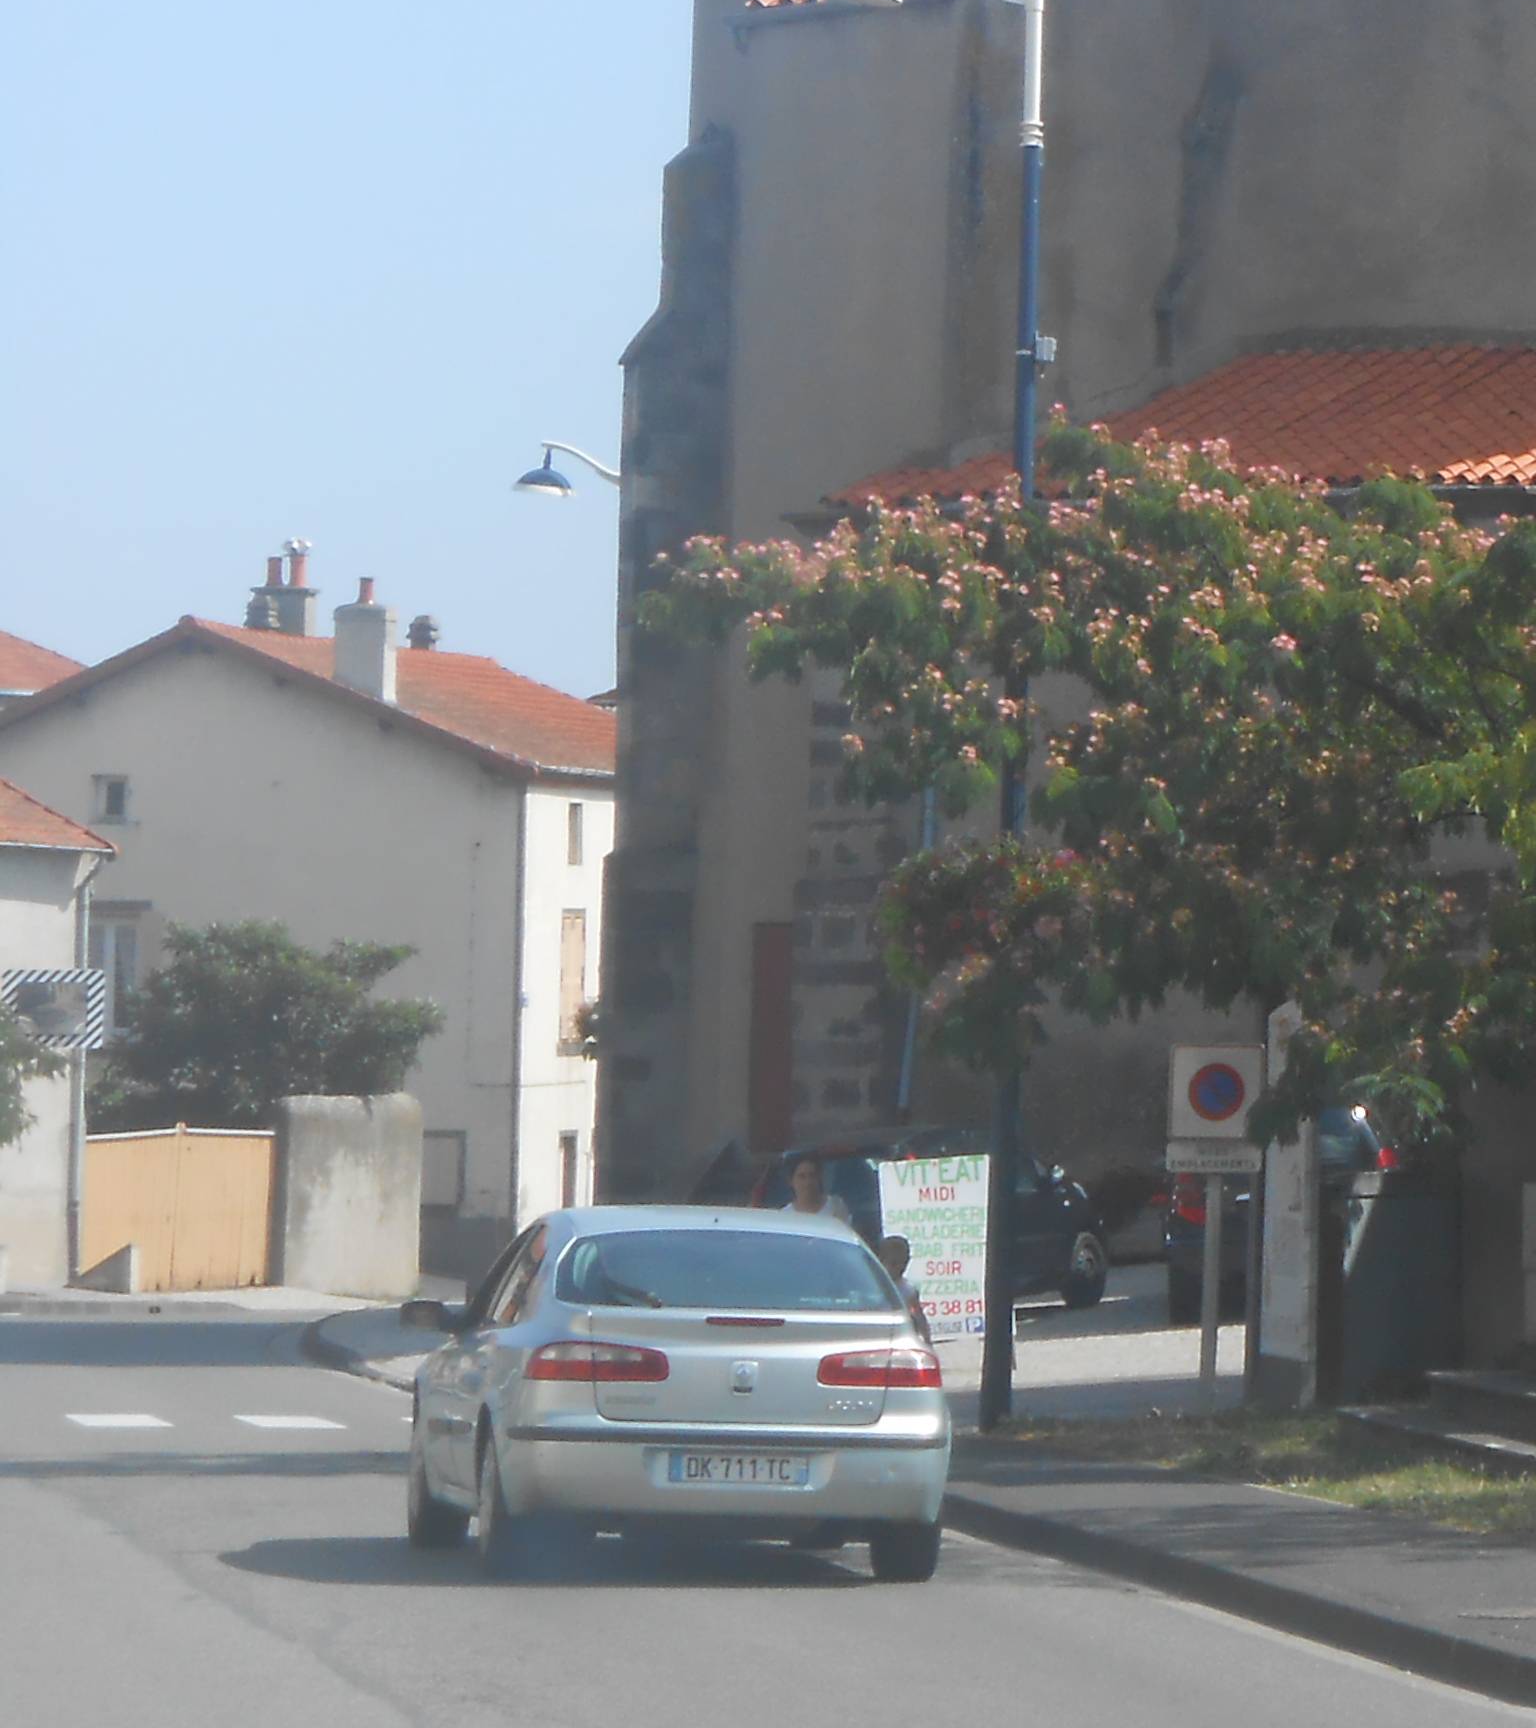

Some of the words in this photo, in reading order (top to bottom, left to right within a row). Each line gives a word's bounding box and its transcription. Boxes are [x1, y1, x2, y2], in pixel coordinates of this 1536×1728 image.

[918, 1186, 956, 1202] MIDI
[926, 1260, 962, 1276] SOIR
[942, 1301, 961, 1315] 38
[965, 1300, 984, 1314] 81
